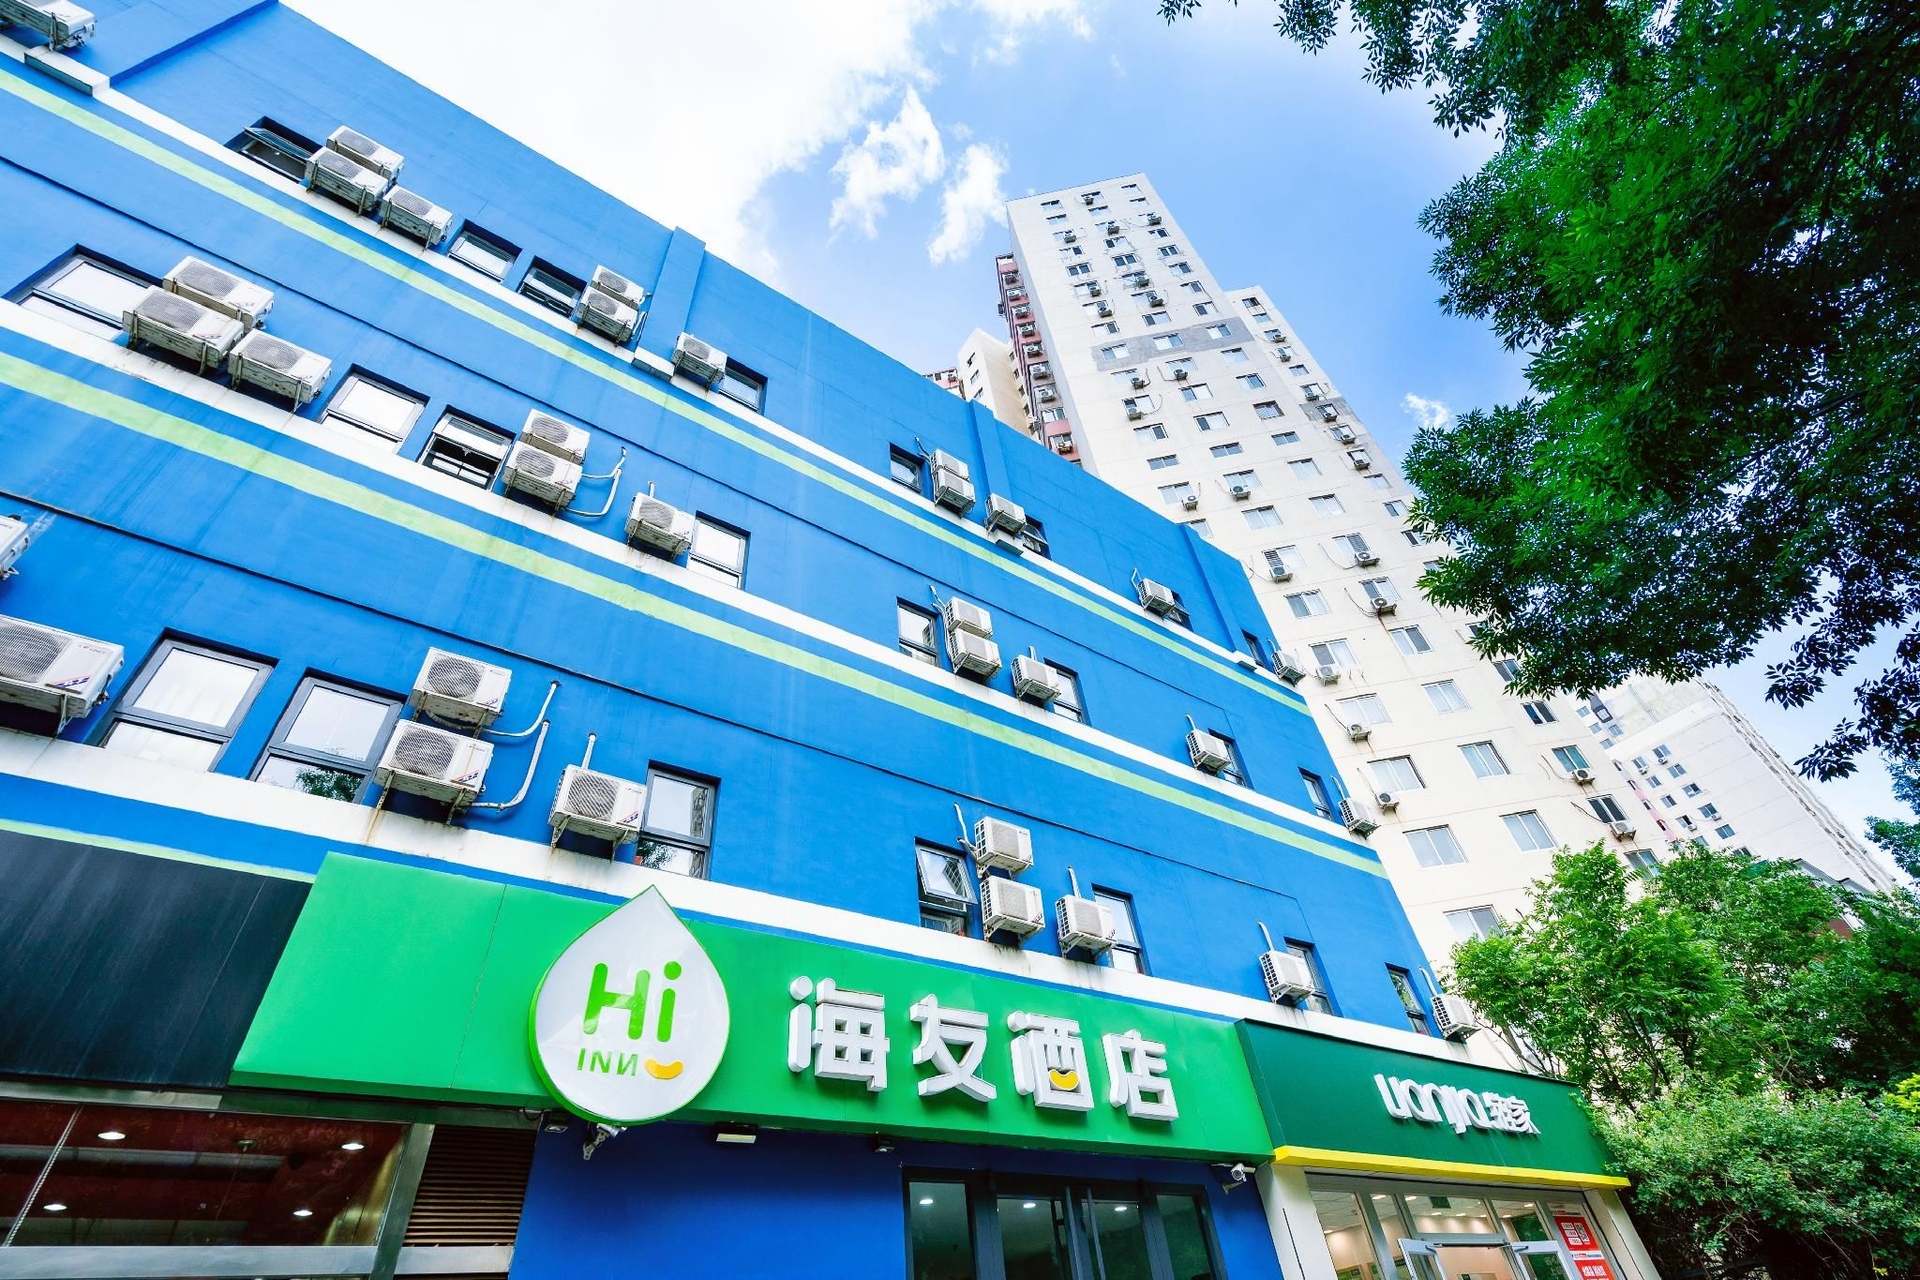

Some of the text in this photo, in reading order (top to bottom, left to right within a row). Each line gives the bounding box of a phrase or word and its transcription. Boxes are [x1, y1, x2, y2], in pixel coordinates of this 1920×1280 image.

[583, 961, 682, 1043] Hi
[787, 975, 1179, 1121] 海友酒店
